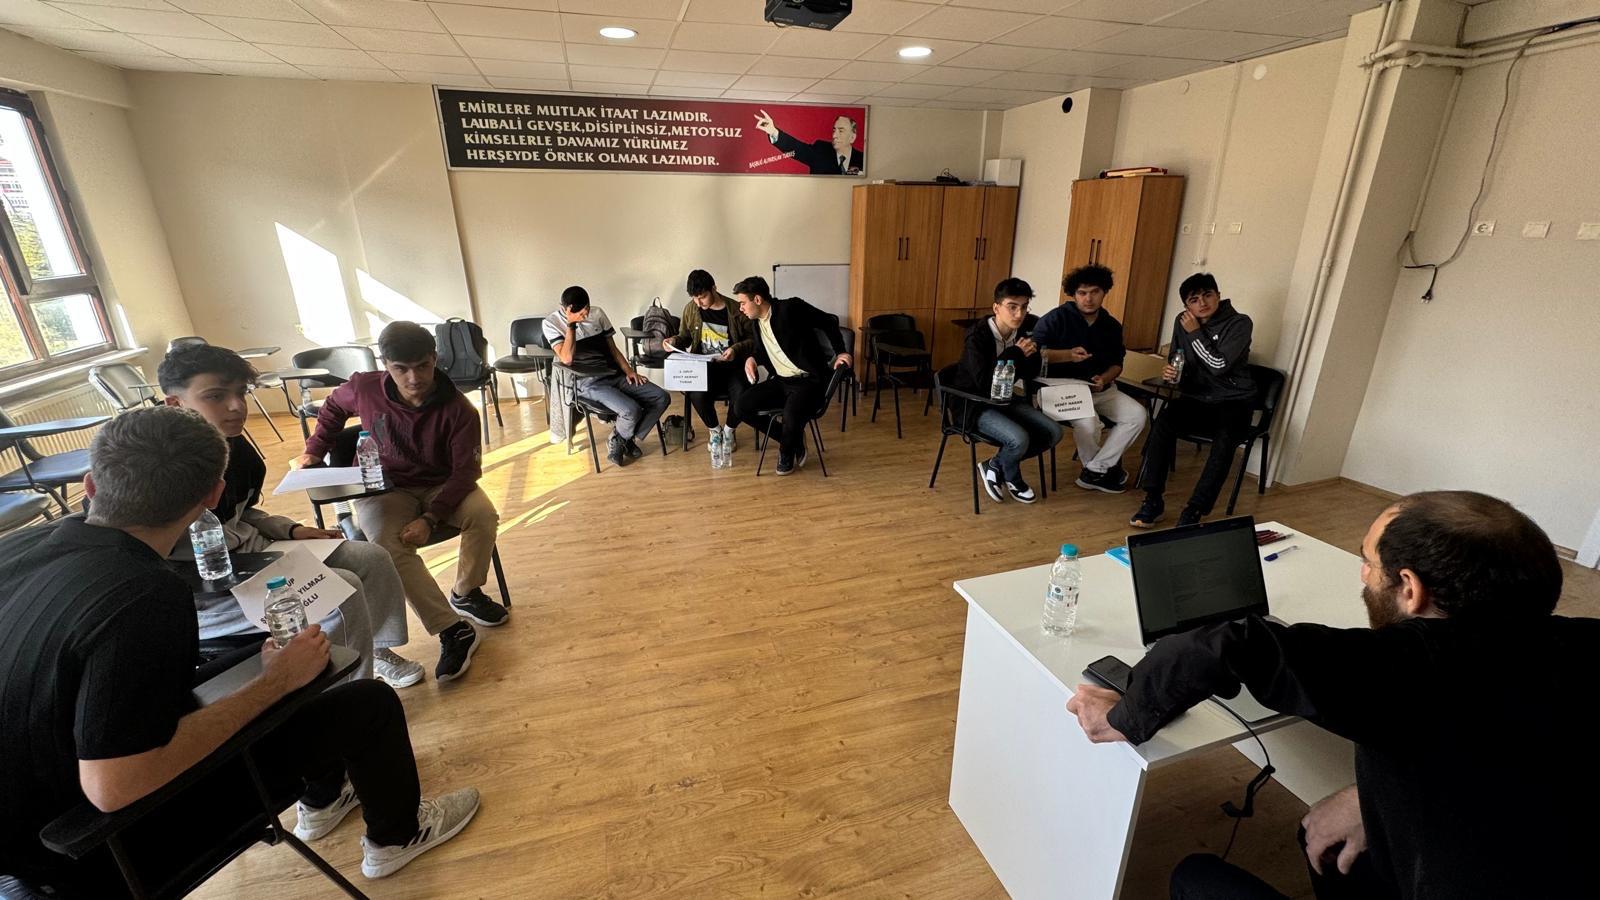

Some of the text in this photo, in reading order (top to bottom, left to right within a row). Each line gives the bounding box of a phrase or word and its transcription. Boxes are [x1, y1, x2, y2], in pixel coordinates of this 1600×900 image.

[458, 101, 712, 123] EMİRLERE MUTLAK İTAAT LAZIMDIR.
[461, 117, 523, 131] LAUBALİ
[463, 131, 689, 151] KİMSELERLE DAVAMIZ YÜRÜMEZ
[466, 149, 720, 166] HERŞEYDE ÖRNEK OLMAK LAZIMDIR.
[298, 574, 326, 594] YILMAZ
